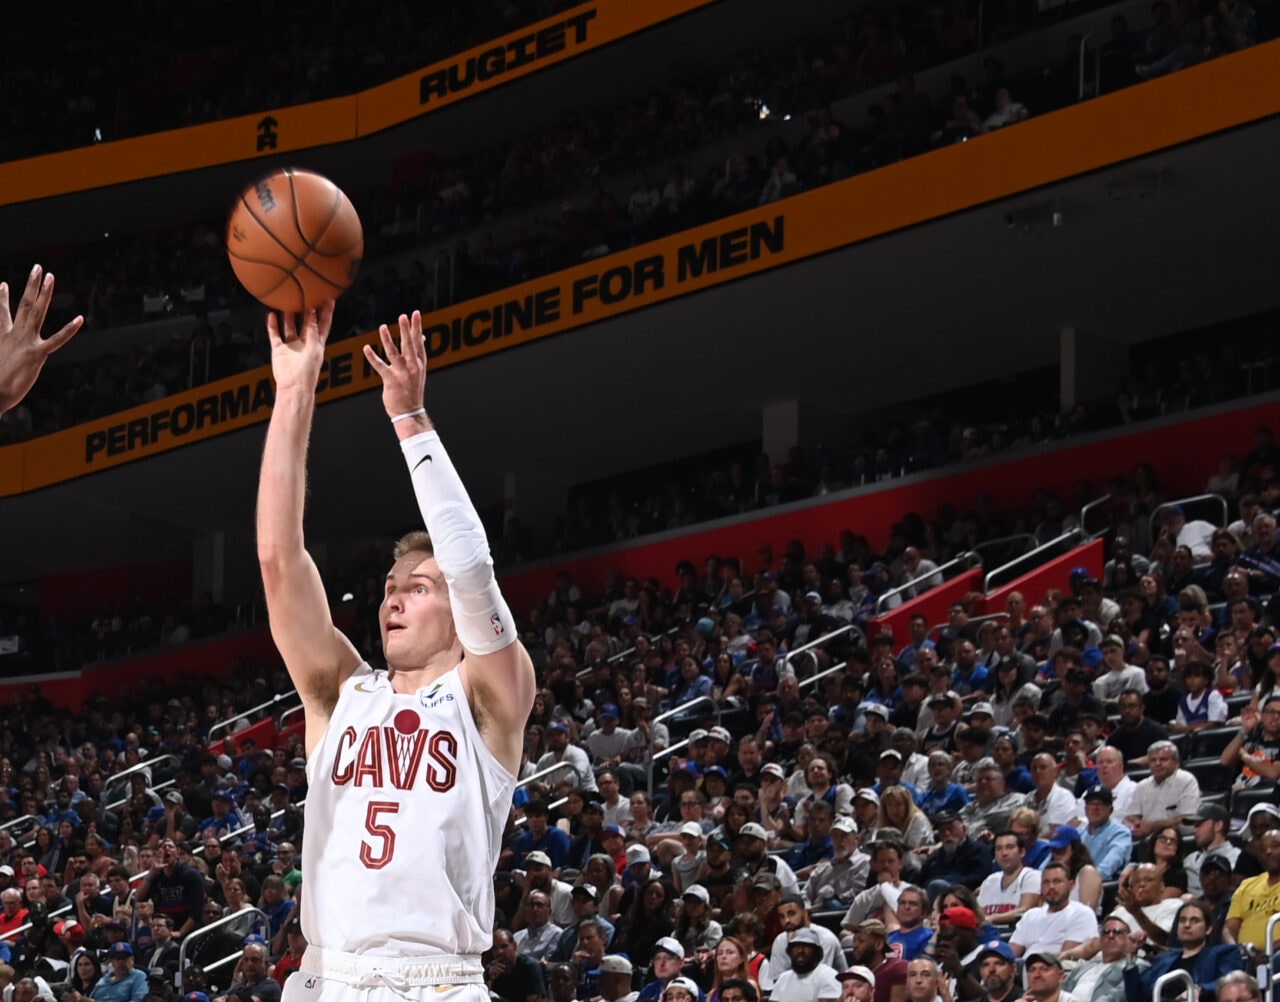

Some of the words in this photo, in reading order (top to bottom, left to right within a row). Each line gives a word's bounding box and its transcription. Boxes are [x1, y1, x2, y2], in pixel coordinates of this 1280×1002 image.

[419, 8, 598, 107] RUGIET
[86, 353, 353, 464] PERFORMAE
[364, 286, 561, 377] DICINE
[572, 254, 665, 316] FOR
[677, 215, 785, 284] MEN
[331, 725, 458, 794] CAVS
[359, 800, 400, 870] 5
